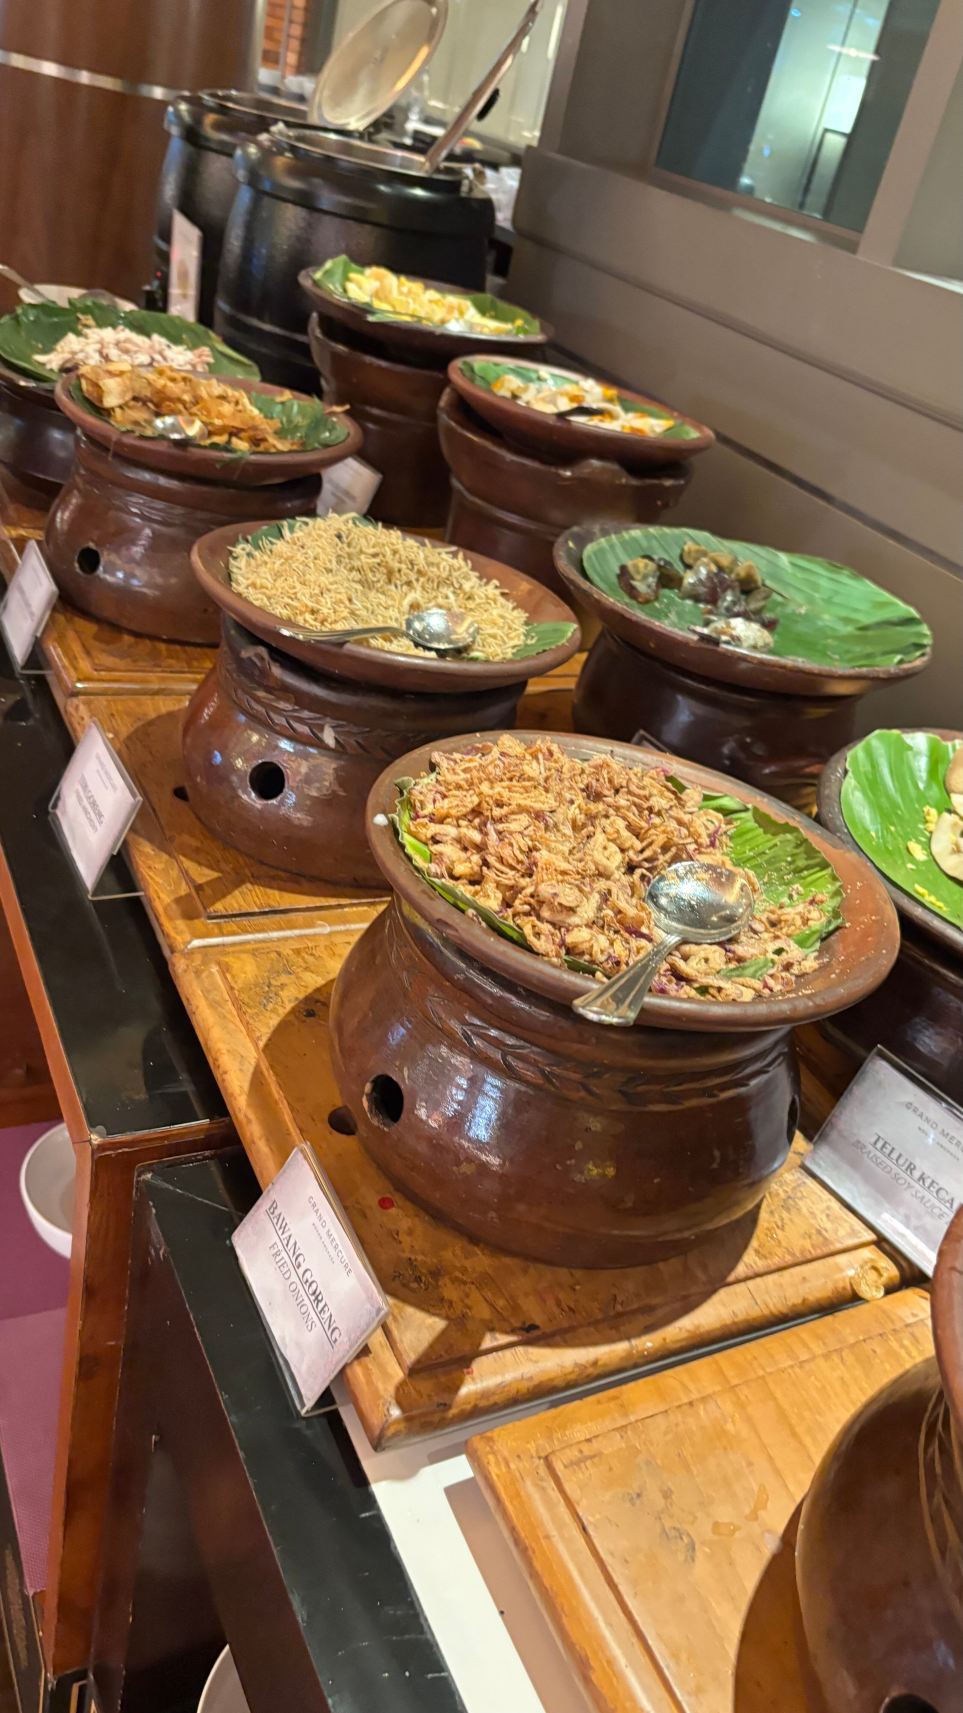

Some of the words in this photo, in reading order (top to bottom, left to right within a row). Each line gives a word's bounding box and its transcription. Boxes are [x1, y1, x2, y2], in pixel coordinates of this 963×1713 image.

[905, 1102, 938, 1130] GRAND
[852, 1139, 894, 1178] BRAISED
[890, 1170, 918, 1192] SOY
[911, 1189, 949, 1221] SAUCE
[872, 1132, 918, 1176] TELUR
[917, 1172, 955, 1210] KECA
[267, 1199, 306, 1270] BAWANG
[301, 1267, 342, 1346] GORENG
[307, 1195, 327, 1229] GRAND
[325, 1228, 353, 1278] MERCURE
[268, 1241, 292, 1282] FRIED
[288, 1280, 317, 1334] ONIONS
